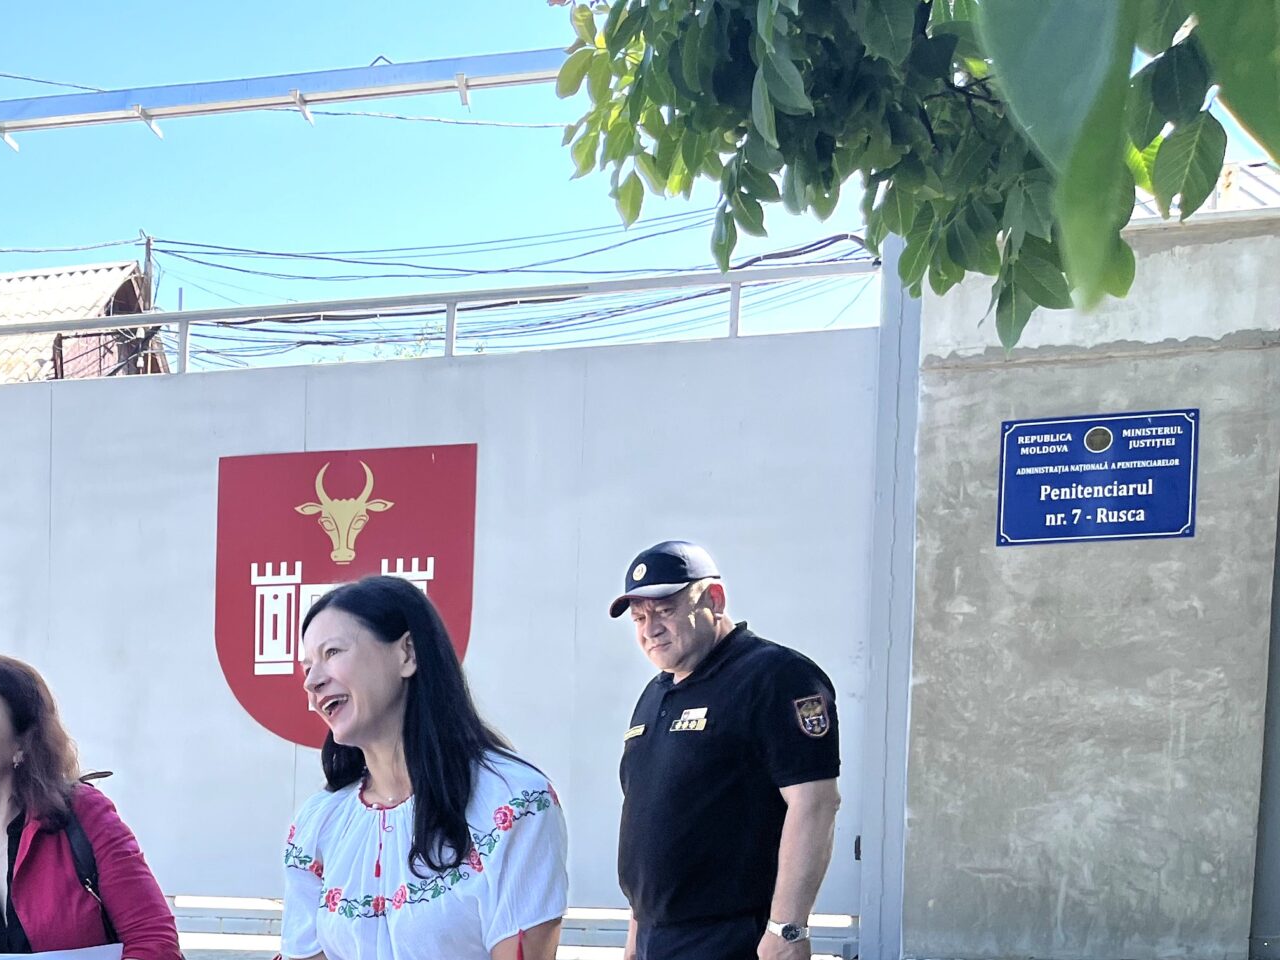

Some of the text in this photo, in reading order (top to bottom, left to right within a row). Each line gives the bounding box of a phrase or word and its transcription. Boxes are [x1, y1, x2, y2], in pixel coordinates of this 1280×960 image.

[1122, 426, 1184, 437] MINISTERUL
[1017, 433, 1072, 445] REPUBLICA
[1020, 444, 1069, 455] MOLDOVA
[1110, 462, 1116, 470] A
[1117, 458, 1180, 469] PENITENCIARELOR
[1039, 479, 1153, 501] Penitenciarul
[1045, 511, 1067, 526] nr.
[1071, 509, 1082, 525] 7
[1096, 508, 1145, 524] Rusca
